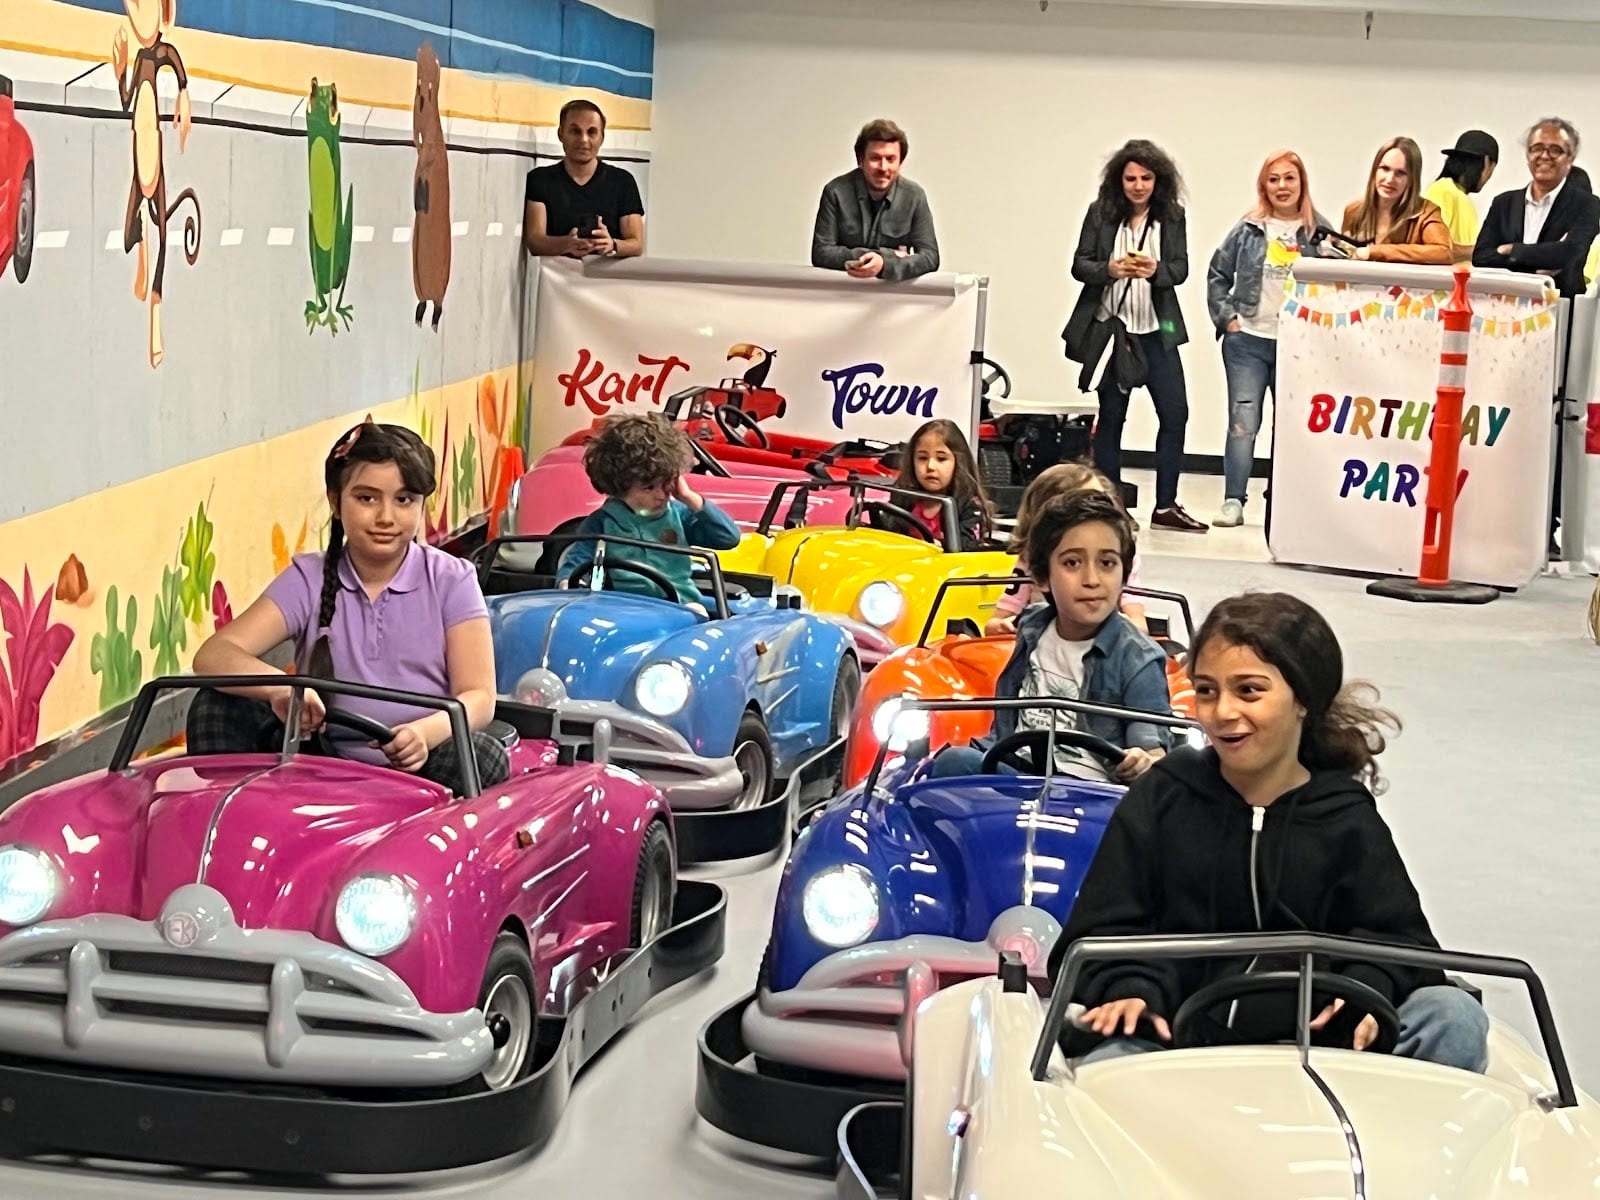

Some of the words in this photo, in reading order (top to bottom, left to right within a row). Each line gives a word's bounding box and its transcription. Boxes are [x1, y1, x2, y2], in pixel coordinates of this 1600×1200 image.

[821, 362, 939, 430] Town
[1307, 393, 1511, 447] BIRTHAY
[1339, 459, 1469, 508] PAR
